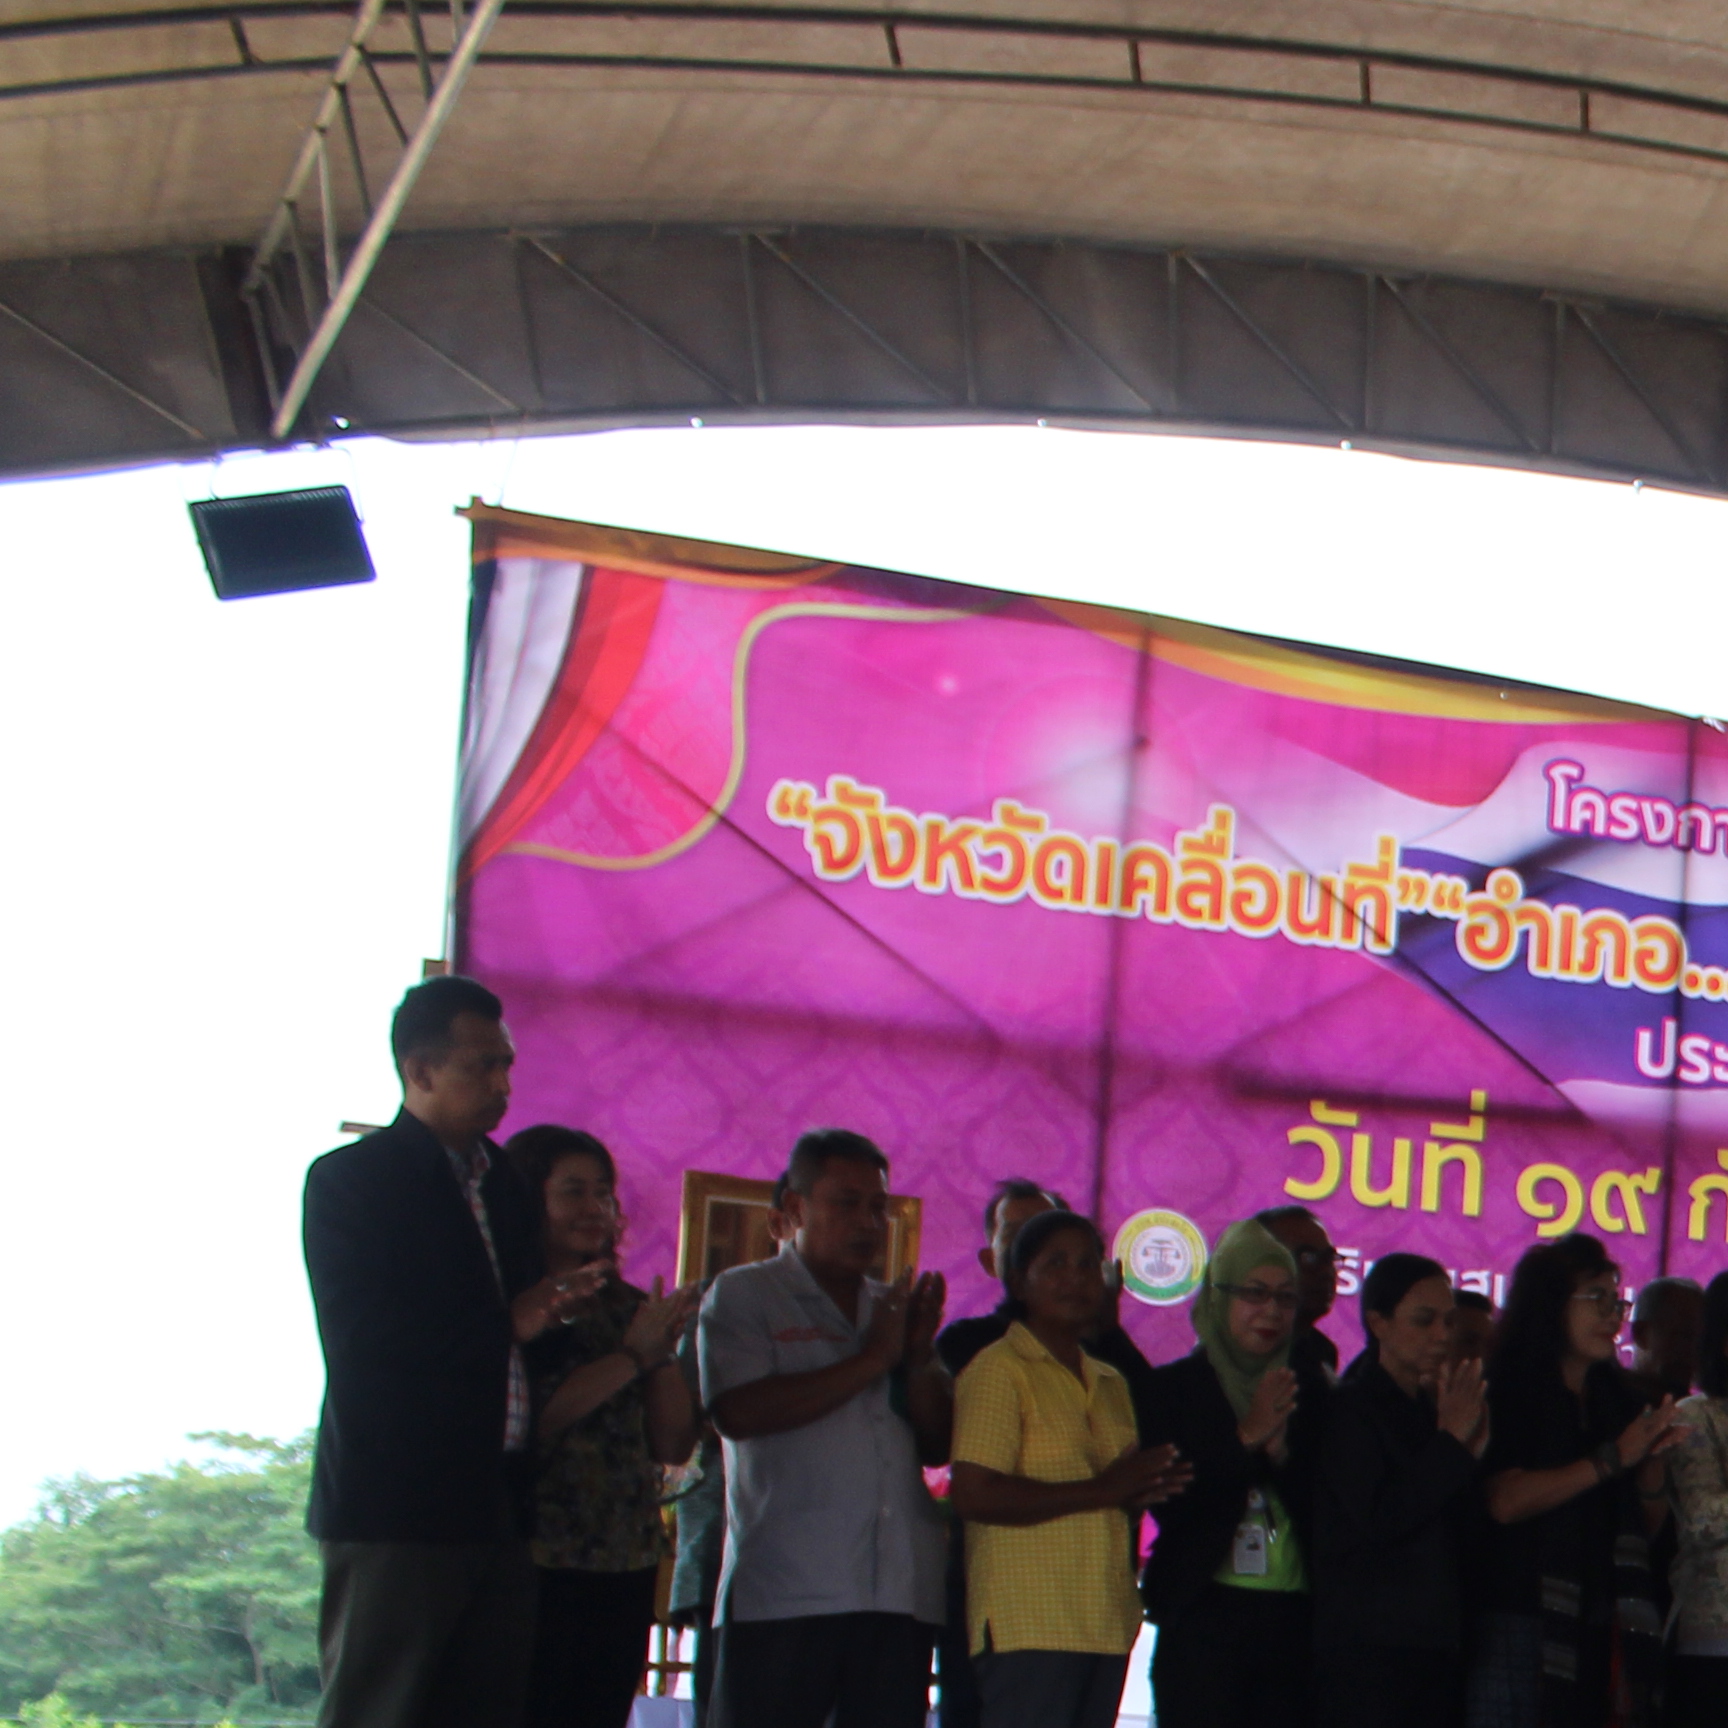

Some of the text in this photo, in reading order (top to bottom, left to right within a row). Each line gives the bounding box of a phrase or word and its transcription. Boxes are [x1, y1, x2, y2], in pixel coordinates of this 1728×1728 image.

[1283, 1091, 1487, 1216] วันที่
[1516, 1160, 1660, 1238] ๑๙
